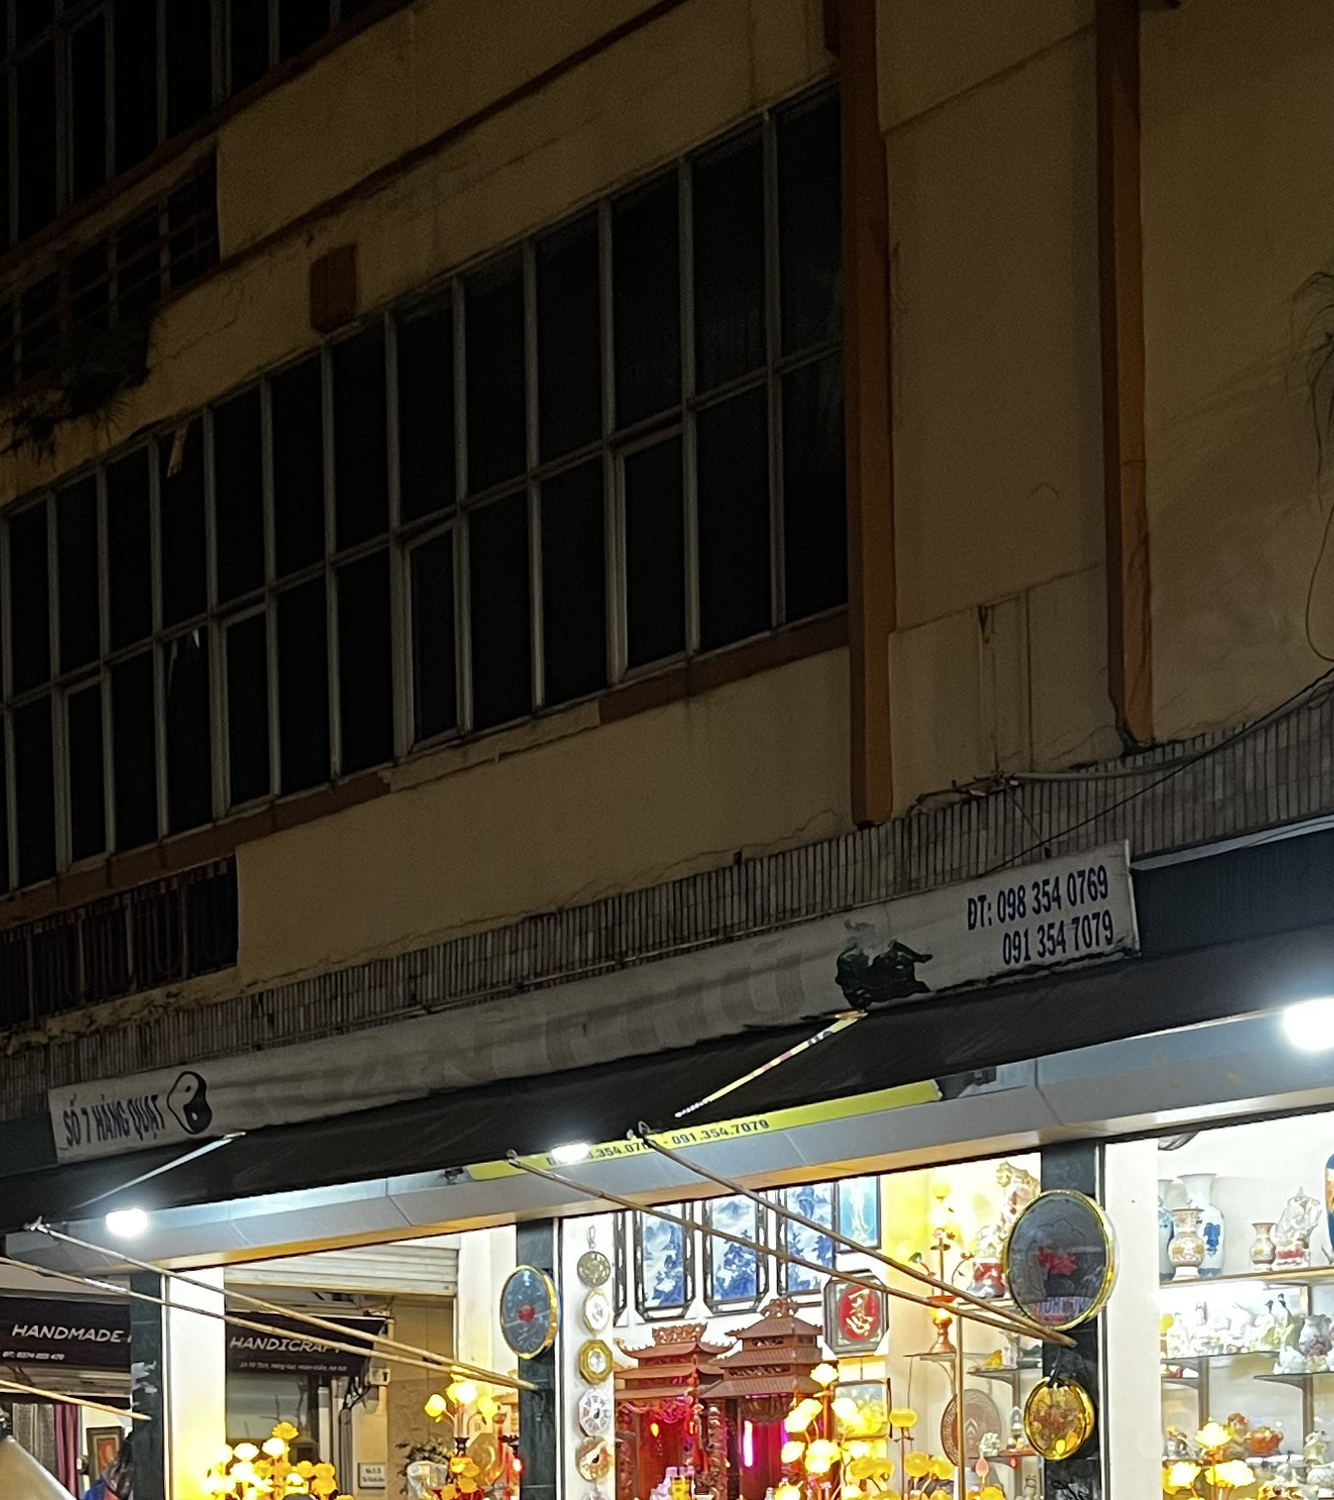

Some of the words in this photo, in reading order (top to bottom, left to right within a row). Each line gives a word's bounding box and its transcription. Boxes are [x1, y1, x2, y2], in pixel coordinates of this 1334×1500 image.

[968, 894, 992, 930] ĐT:
[997, 885, 1026, 923] 098
[1032, 876, 1061, 915] 354
[1067, 865, 1108, 906] 0769
[1003, 928, 1031, 965] 091
[1037, 920, 1066, 958] 354
[1072, 909, 1113, 951] 7079
[63, 1094, 80, 1147] SỐ
[81, 1107, 91, 1143] 7
[128, 1095, 165, 1141] QUẠT
[11, 1324, 125, 1343] HANDMADE
